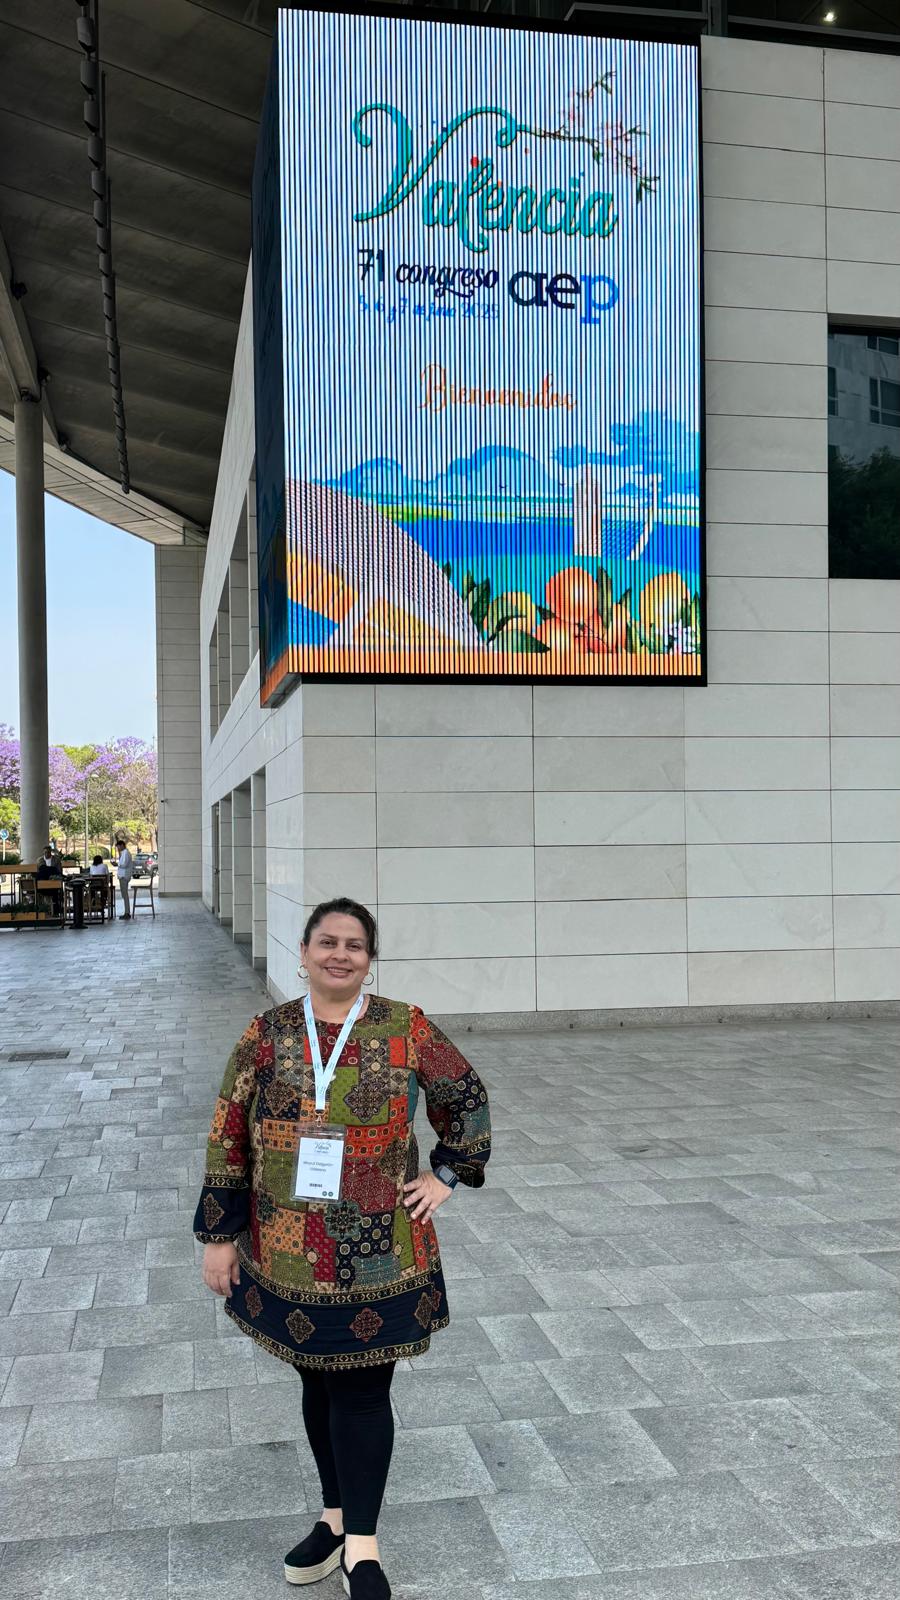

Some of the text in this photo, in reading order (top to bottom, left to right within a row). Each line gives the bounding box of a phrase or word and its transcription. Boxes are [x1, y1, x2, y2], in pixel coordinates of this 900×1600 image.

[352, 103, 618, 252] Valencia
[358, 249, 619, 324] 71 congreso aep
